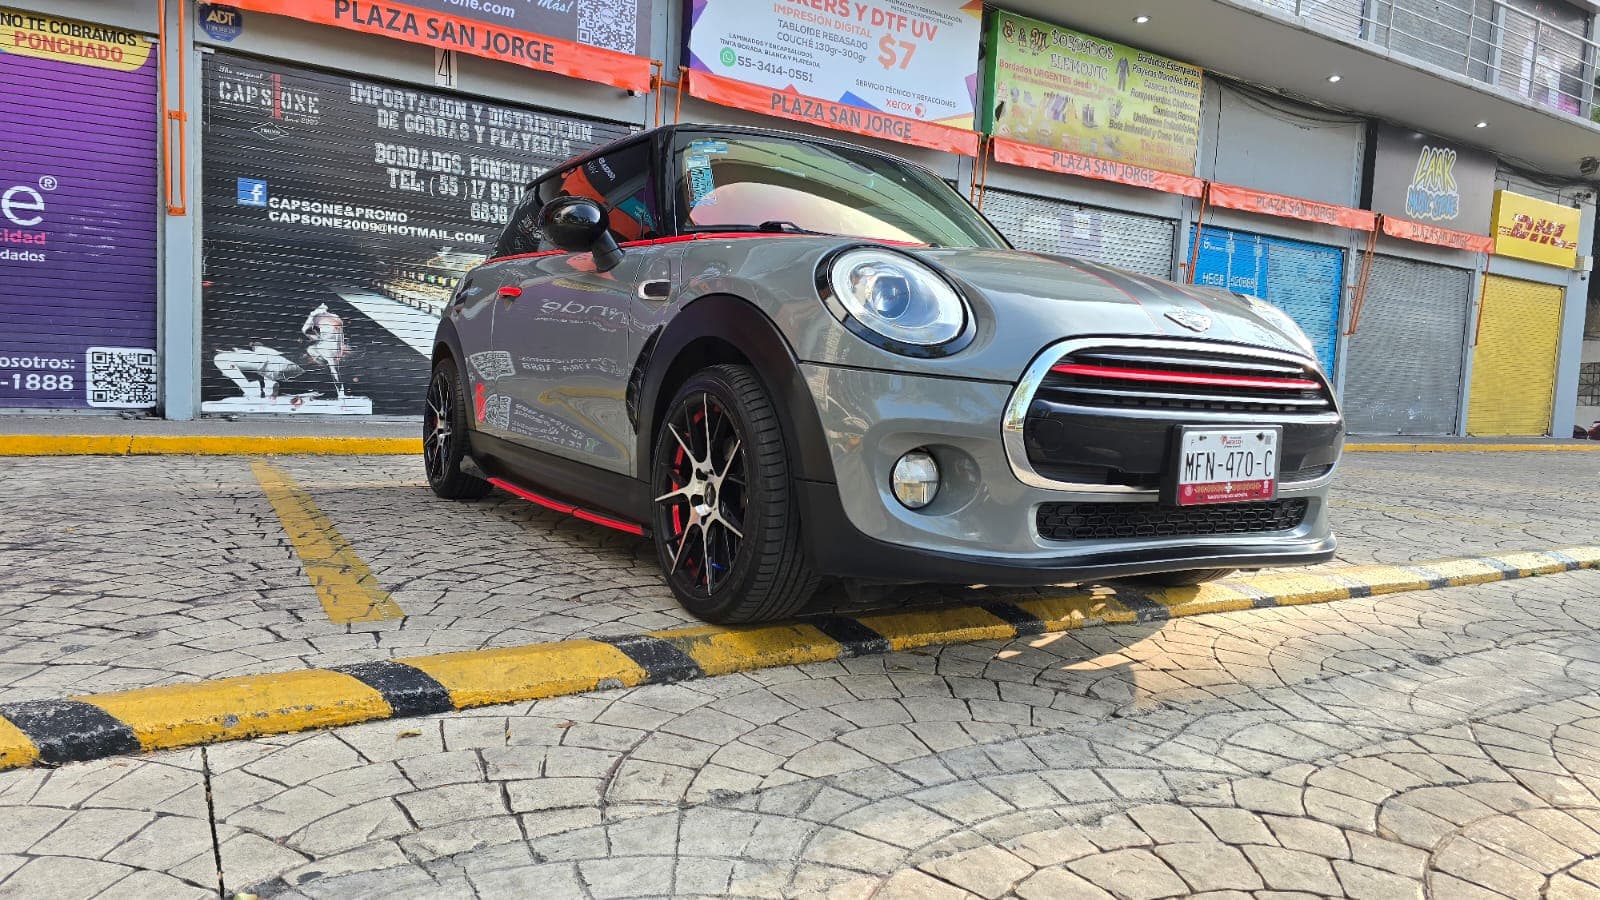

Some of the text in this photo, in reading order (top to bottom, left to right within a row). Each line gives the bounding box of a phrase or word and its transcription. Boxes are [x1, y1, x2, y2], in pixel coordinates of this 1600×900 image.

[206, 10, 235, 26] ADT
[443, 0, 515, 18] one.com
[855, 3, 868, 21] Y
[871, 8, 907, 32] DTF
[912, 19, 938, 41] UV
[1, 13, 137, 46] NO TE COBRAMOS
[335, 0, 555, 66] PLAZA SAN JORGE
[823, 31, 868, 50] REBASADO
[834, 19, 872, 39] DIGITAL
[14, 30, 124, 63] PONCHADO
[776, 31, 868, 64] COUCHÉ 130gr-300gr
[878, 33, 917, 70] $7
[737, 55, 814, 83] 55-3414-0551
[999, 58, 1032, 75] Bordados
[1034, 67, 1073, 85] URGENTES
[855, 78, 884, 91] SERVICIO
[472, 104, 483, 123] Y
[771, 93, 912, 139] PLAZA SAN JORGE
[886, 98, 912, 112] xerox
[377, 109, 570, 157] DE GORRAS Y PLAYERAS
[1052, 151, 1155, 183] PLAZA SAN JORGE
[470, 179, 486, 199] 17
[268, 197, 408, 224] CAPSONE&PROMO
[1256, 196, 1337, 221] PLAZA SAN JORGE
[268, 211, 486, 244] CAPSONE2009@HOTMAIL.COM
[1413, 224, 1434, 239] PLAZA
[1511, 213, 1566, 249] DHL
[1184, 449, 1273, 481] MFN-470-C
